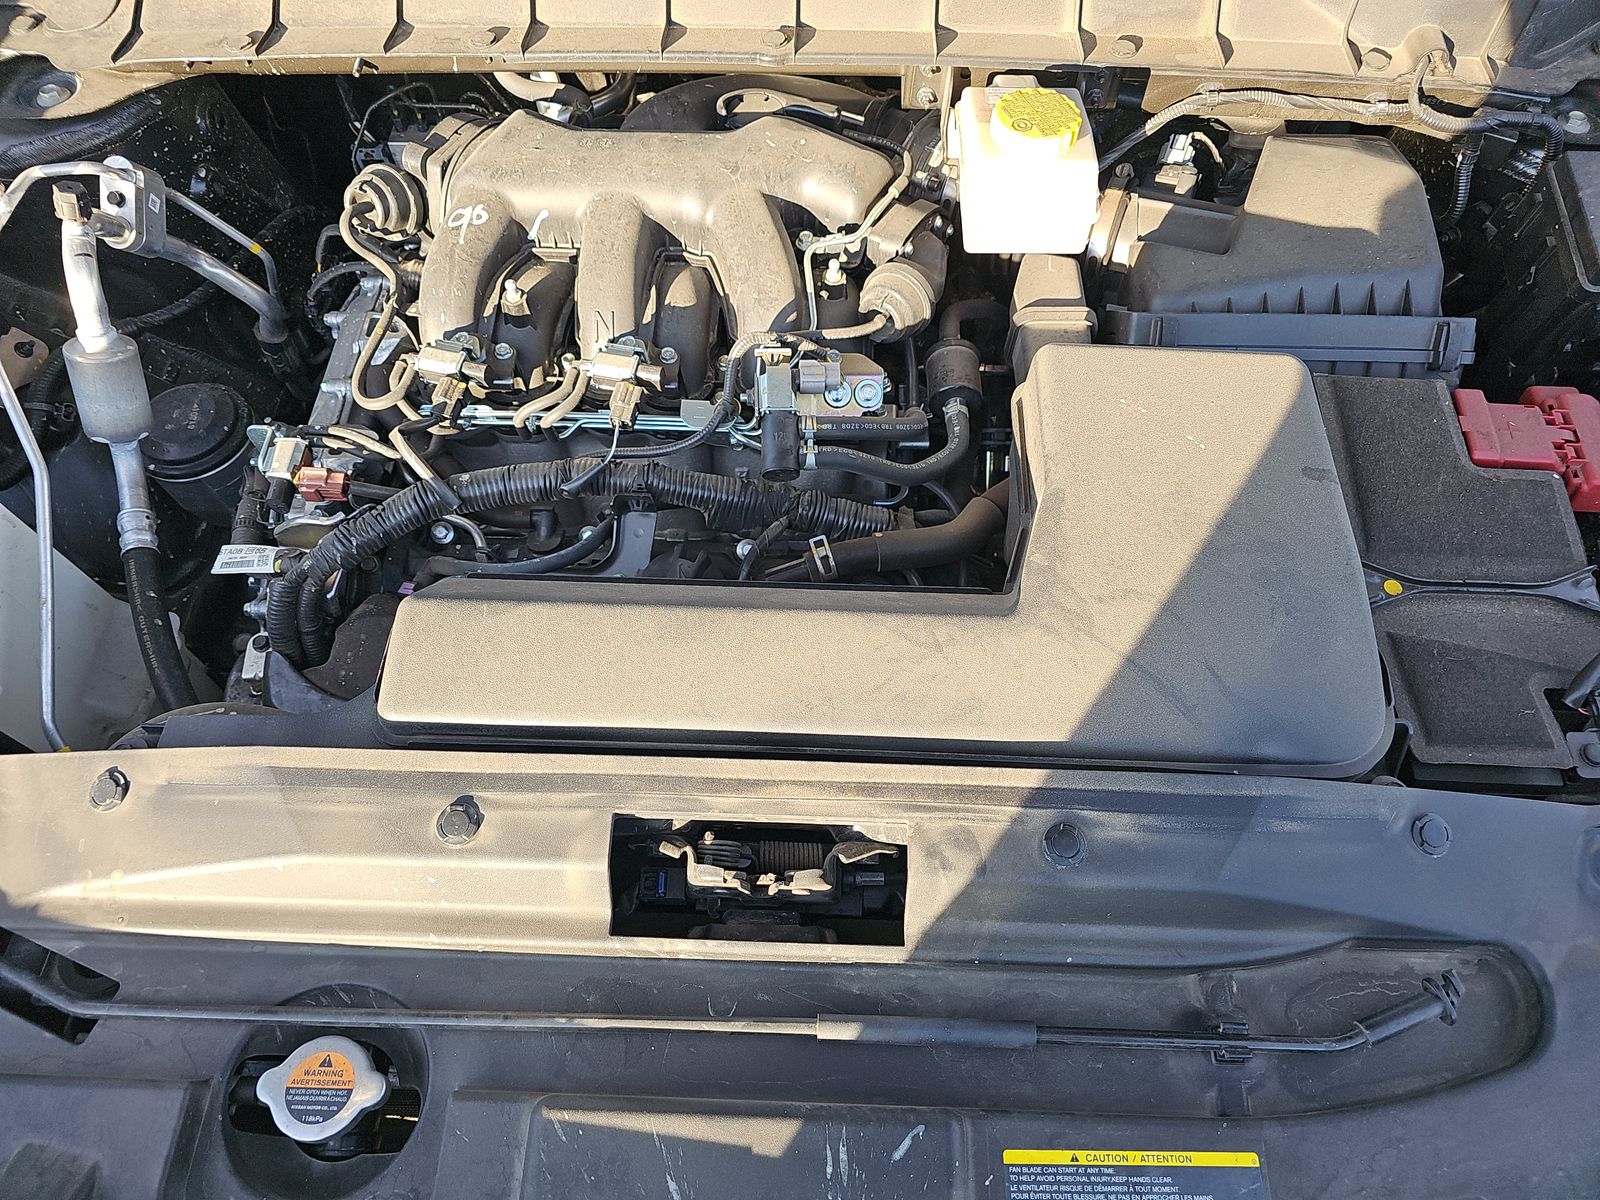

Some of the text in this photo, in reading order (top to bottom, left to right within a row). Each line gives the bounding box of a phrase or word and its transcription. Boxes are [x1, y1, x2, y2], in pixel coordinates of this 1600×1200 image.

[303, 1069, 344, 1078] WARNING
[290, 1078, 353, 1087] AVERTISSEMENT
[1085, 1153, 1129, 1163] CAUTION
[1140, 1154, 1192, 1164] ATTENTION
[1151, 1176, 1173, 1184] CLEAR.
[1094, 1183, 1128, 1192] DÉMARRER
[1030, 1191, 1051, 1200] ÉVITER
